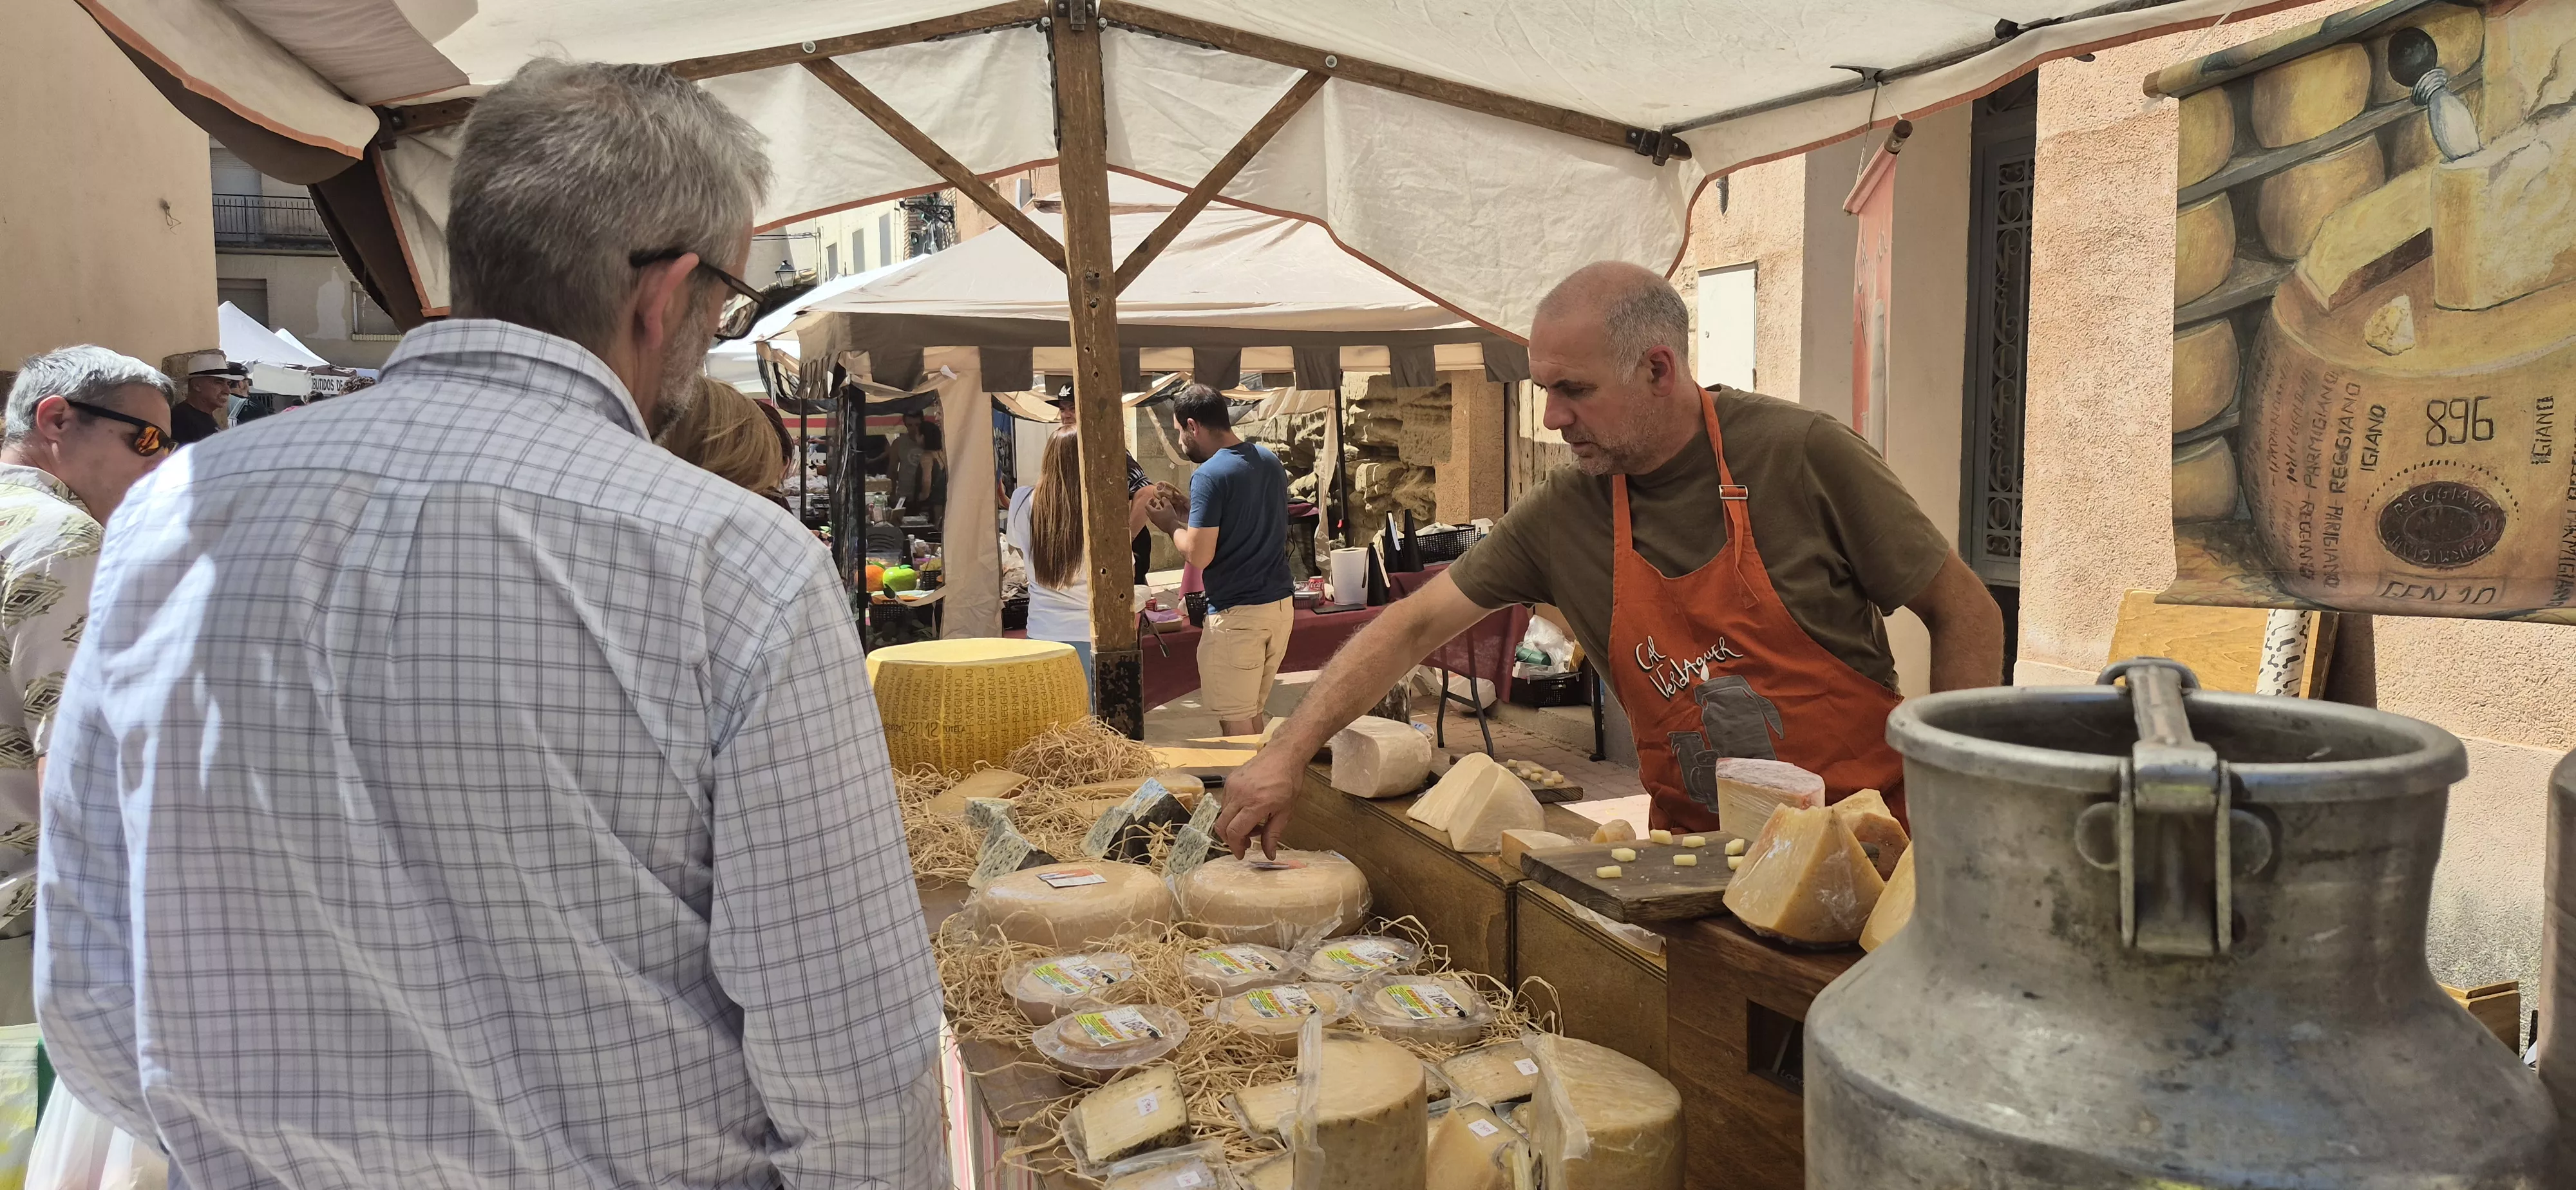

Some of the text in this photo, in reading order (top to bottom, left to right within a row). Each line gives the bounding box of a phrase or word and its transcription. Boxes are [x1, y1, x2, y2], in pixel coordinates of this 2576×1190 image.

[312, 378, 335, 391] BUTIDOS
[2329, 382, 2361, 494] REGGIANO
[2360, 404, 2388, 471] IGIANO
[2426, 396, 2494, 446] 896
[2380, 581, 2447, 601] GEN
[977, 677, 986, 726] REGGIANO
[987, 668, 998, 724] PARMIGIANO
[999, 677, 1009, 724] REGGIANO
[1007, 666, 1019, 723] PARMIGIANO
[1019, 675, 1030, 722] REGGIANO
[1027, 665, 1040, 721] PARMIGIANO
[1037, 673, 1048, 719] REGGIANO
